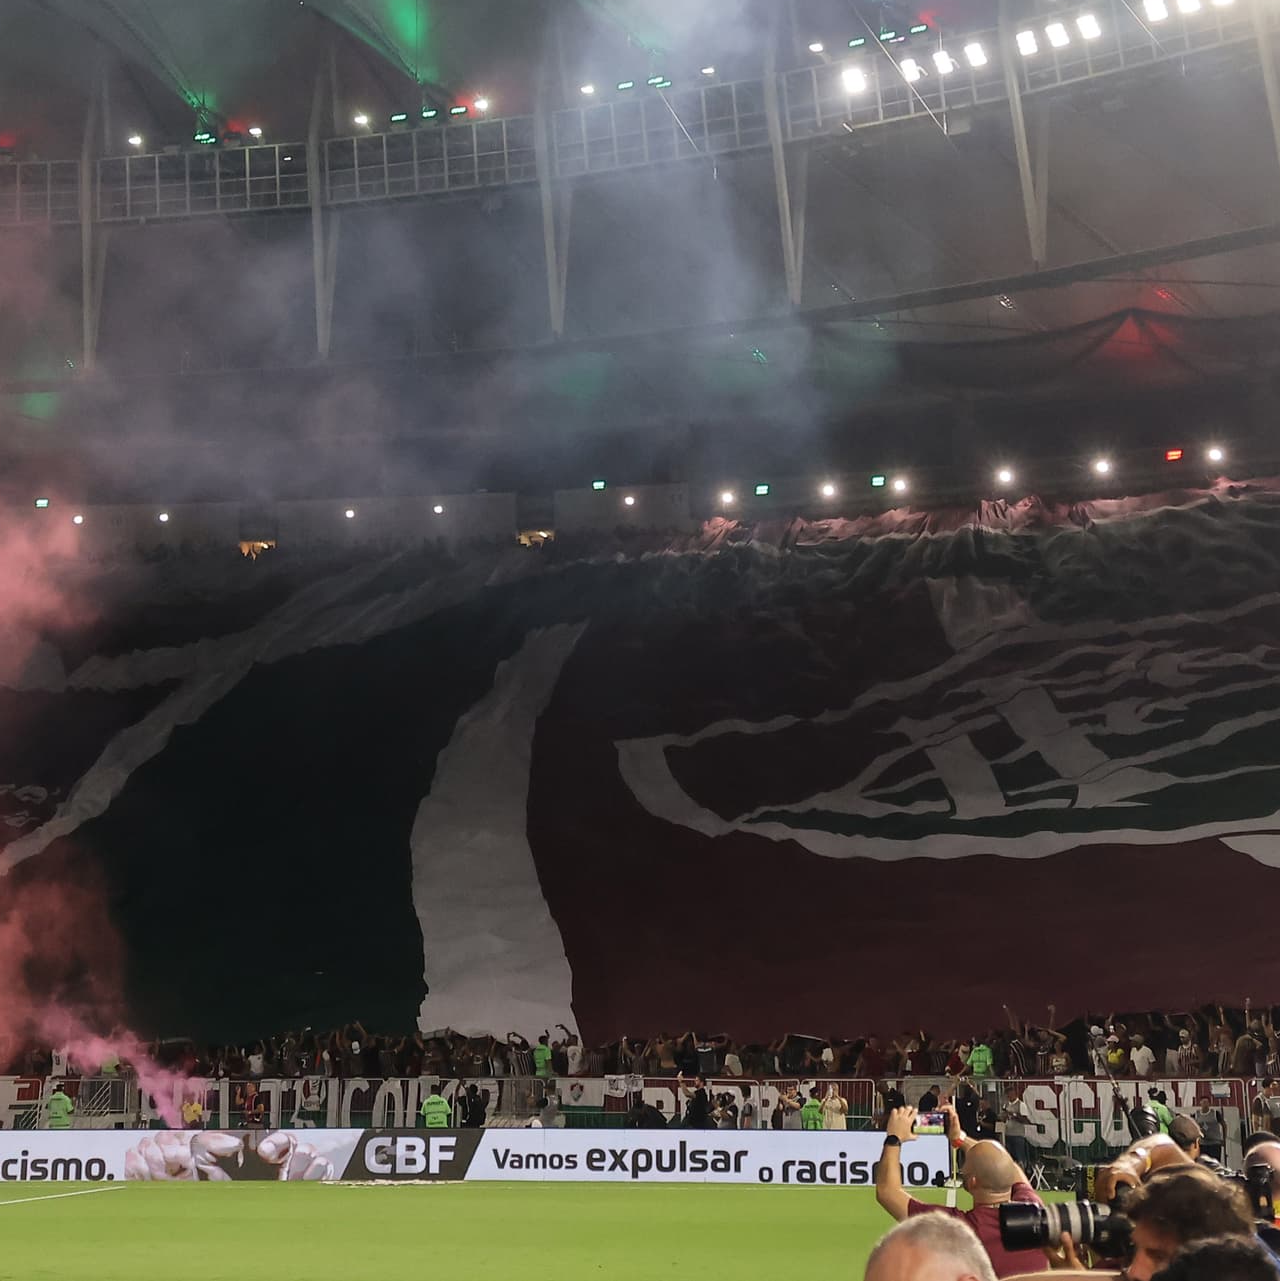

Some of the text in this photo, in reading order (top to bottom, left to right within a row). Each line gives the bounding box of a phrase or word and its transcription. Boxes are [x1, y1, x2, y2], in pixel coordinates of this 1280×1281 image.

[364, 1137, 457, 1175] CBF
[492, 1148, 578, 1171] Vamos
[586, 1141, 748, 1179] expulsar
[758, 1166, 773, 1183] o
